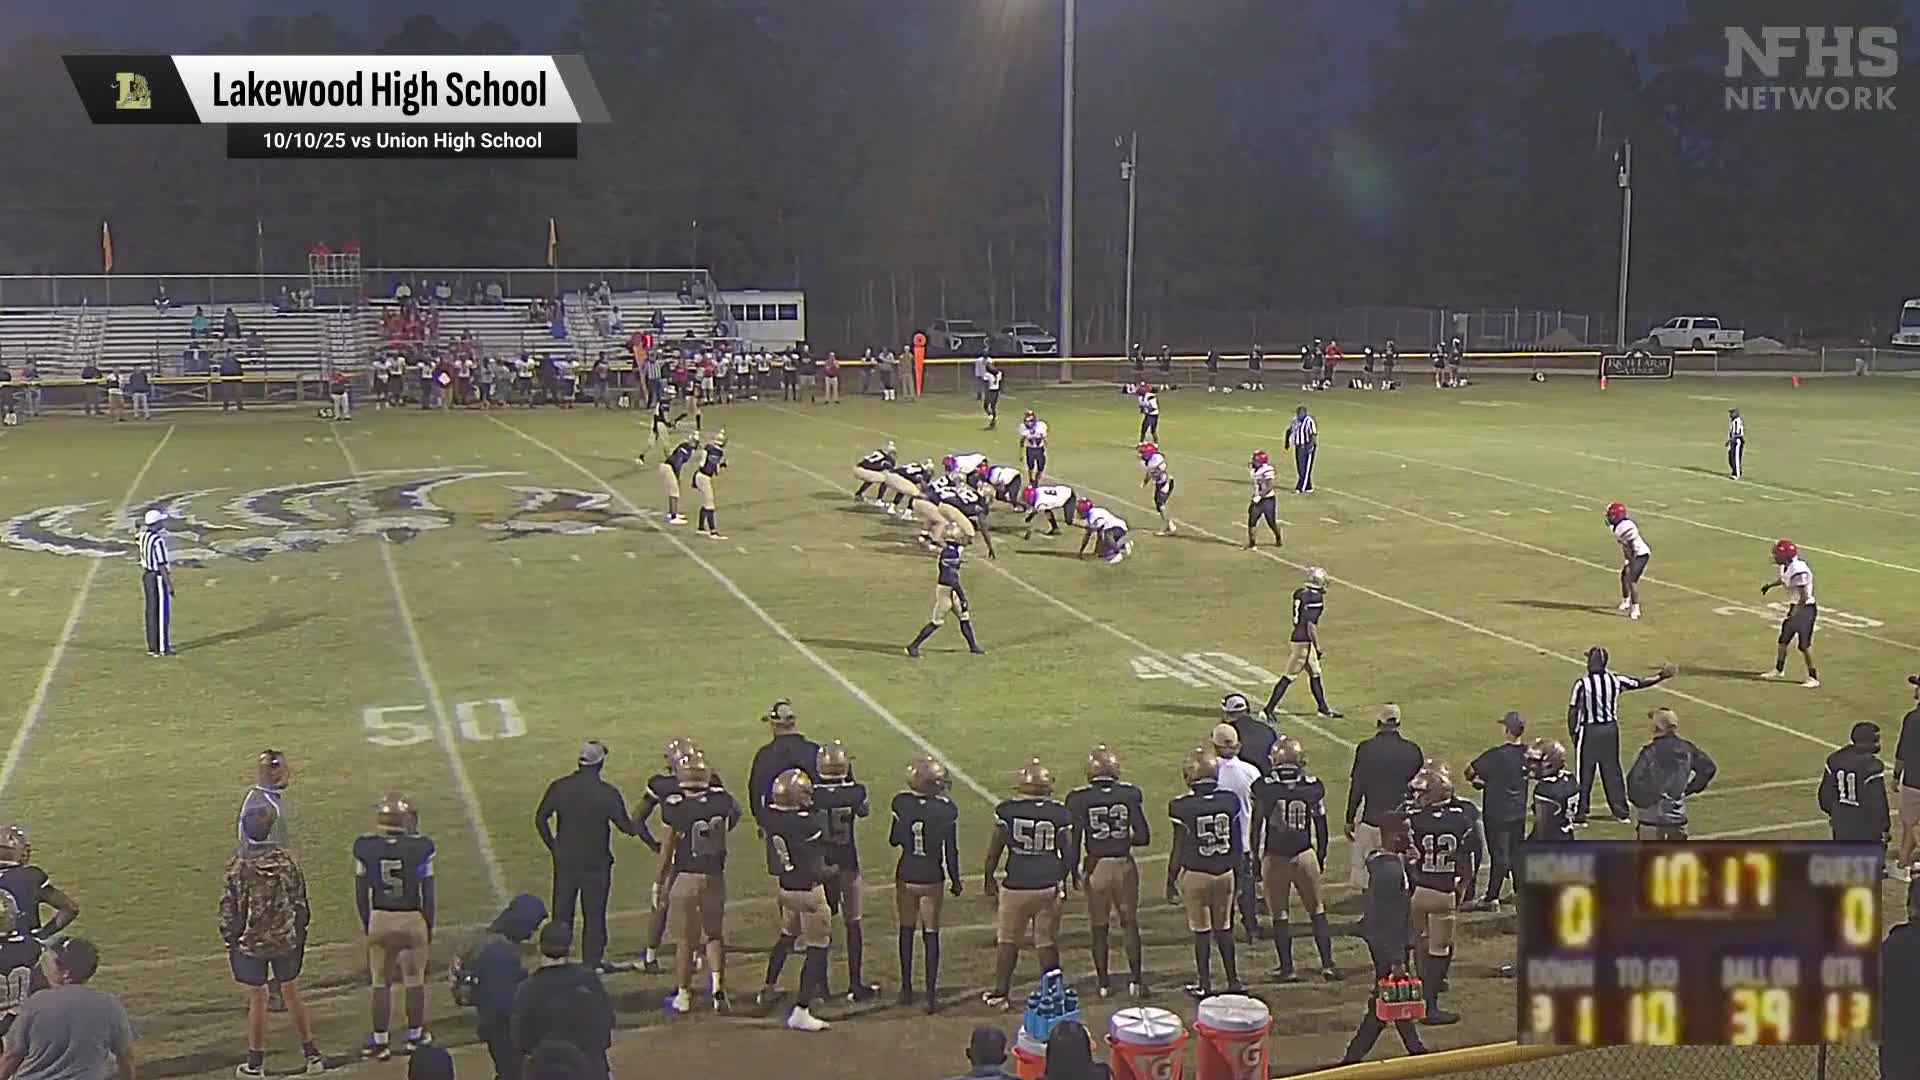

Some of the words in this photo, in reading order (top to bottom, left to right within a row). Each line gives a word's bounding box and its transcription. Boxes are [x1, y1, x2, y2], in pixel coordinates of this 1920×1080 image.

[1130, 651, 1282, 688] 40
[363, 698, 527, 746] 50
[912, 821, 927, 857] 1
[1013, 818, 1056, 855] 50
[1088, 803, 1129, 840] 53
[1196, 813, 1231, 857] 59
[1422, 833, 1458, 872] 12
[1526, 854, 1596, 883] HOME
[1808, 856, 1878, 884] GUEST
[380, 859, 404, 897] 5
[1557, 886, 1594, 946] 0
[1842, 887, 1875, 946] 0
[1527, 958, 1595, 987] DOWN
[1616, 958, 1643, 987] TO
[1648, 958, 1679, 987] GO
[1722, 958, 1766, 987] BALL
[1770, 958, 1799, 987] ON
[1821, 958, 1863, 987] QTR
[1630, 990, 1678, 1045] 10
[1731, 988, 1791, 1045] 39
[1243, 1041, 1262, 1067] G
